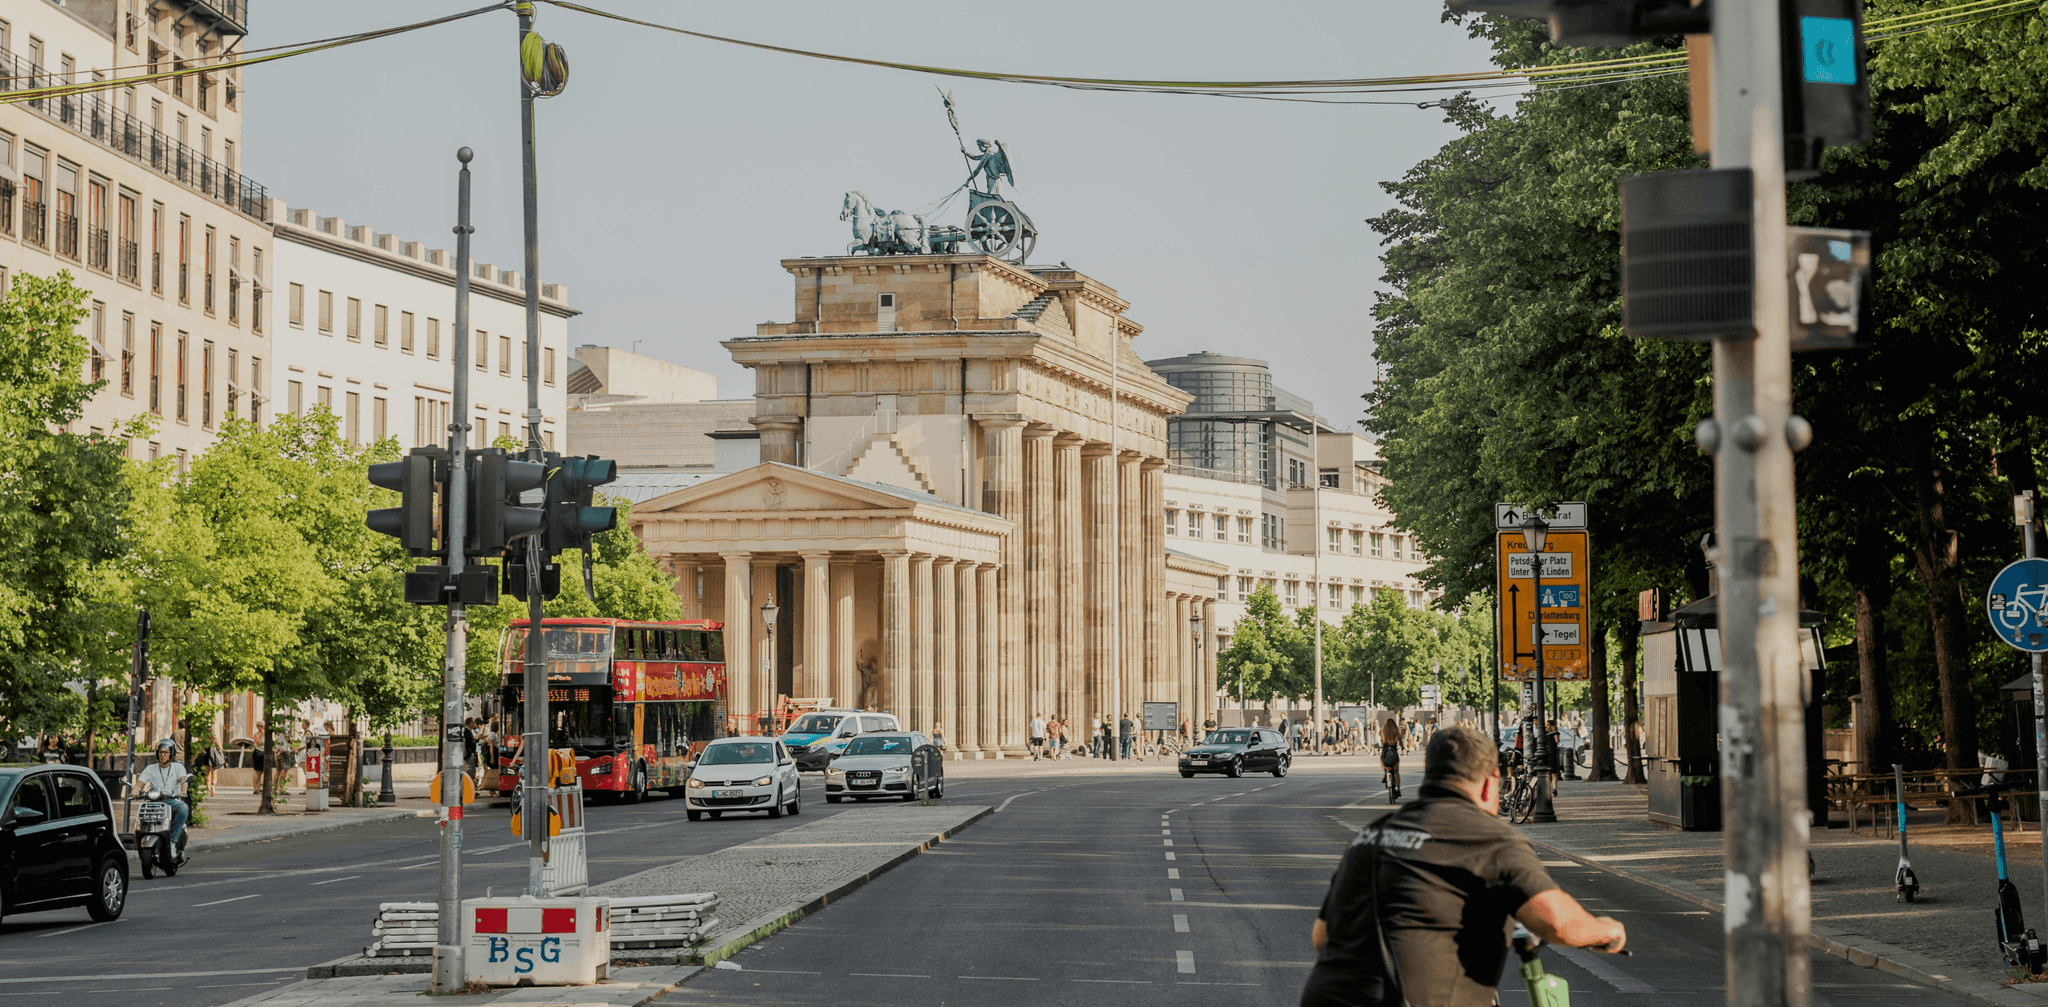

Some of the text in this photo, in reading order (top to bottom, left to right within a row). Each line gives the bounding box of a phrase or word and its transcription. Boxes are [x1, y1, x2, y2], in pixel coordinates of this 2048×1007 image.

[1507, 541, 1554, 551] Kreurg
[1549, 556, 1567, 565] Platz
[1510, 567, 1529, 576] Unter
[1546, 567, 1569, 576] Linden
[1553, 629, 1577, 640] Tegel
